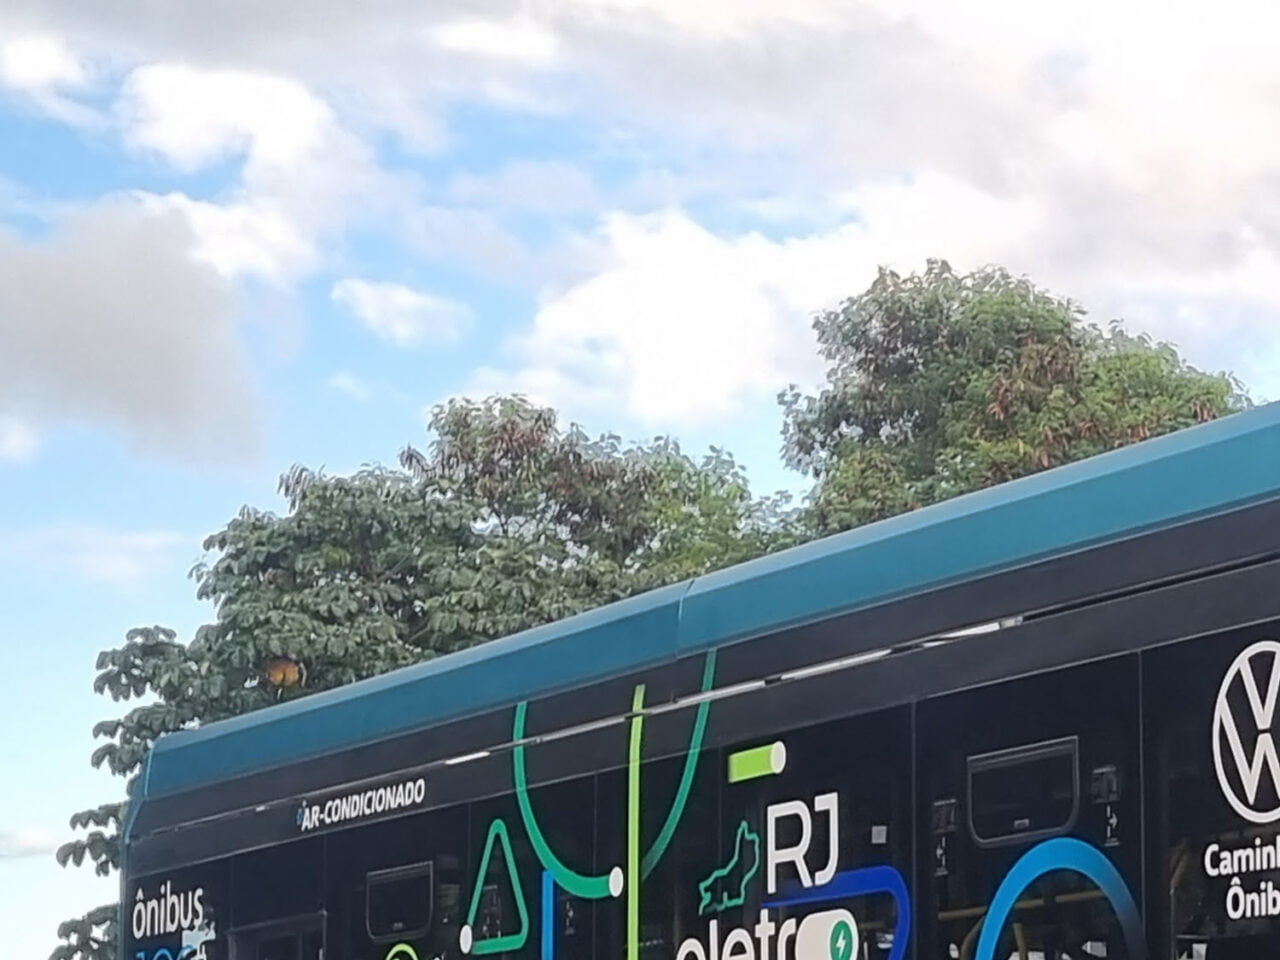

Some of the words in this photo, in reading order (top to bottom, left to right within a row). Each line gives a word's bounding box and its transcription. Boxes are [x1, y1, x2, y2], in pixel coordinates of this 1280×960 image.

[301, 779, 426, 832] AR-CONDICIONADO
[767, 792, 838, 894] RJ
[132, 880, 204, 939] ônibus
